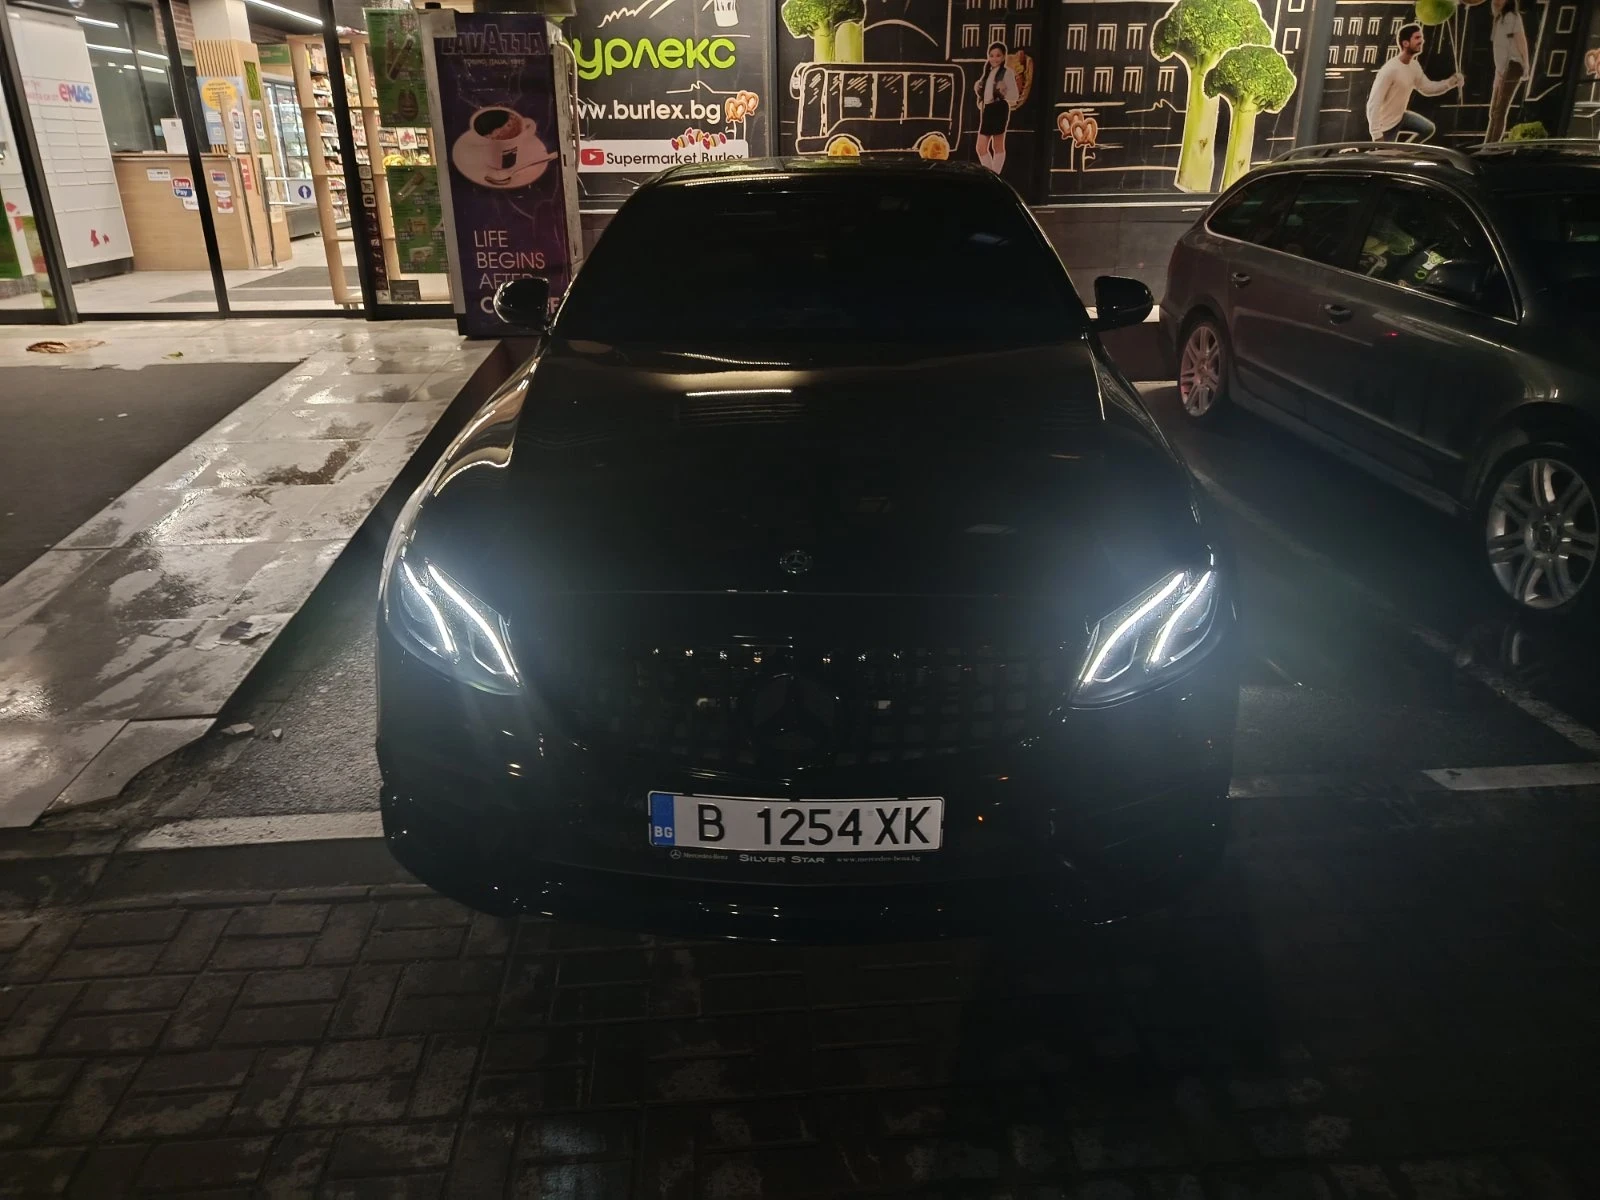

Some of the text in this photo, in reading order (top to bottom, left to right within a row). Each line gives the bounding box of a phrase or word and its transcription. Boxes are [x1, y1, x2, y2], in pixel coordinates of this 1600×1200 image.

[441, 24, 545, 55] LAVAZZA
[568, 37, 736, 80] урлекс
[570, 100, 721, 124] ww.burlex.bg
[606, 152, 697, 167] Supermarket
[474, 230, 508, 247] LIFE
[476, 252, 546, 269] BEGINS
[479, 273, 533, 290] AFT
[654, 826, 673, 838] BG
[698, 803, 931, 846] B 1254 XK
